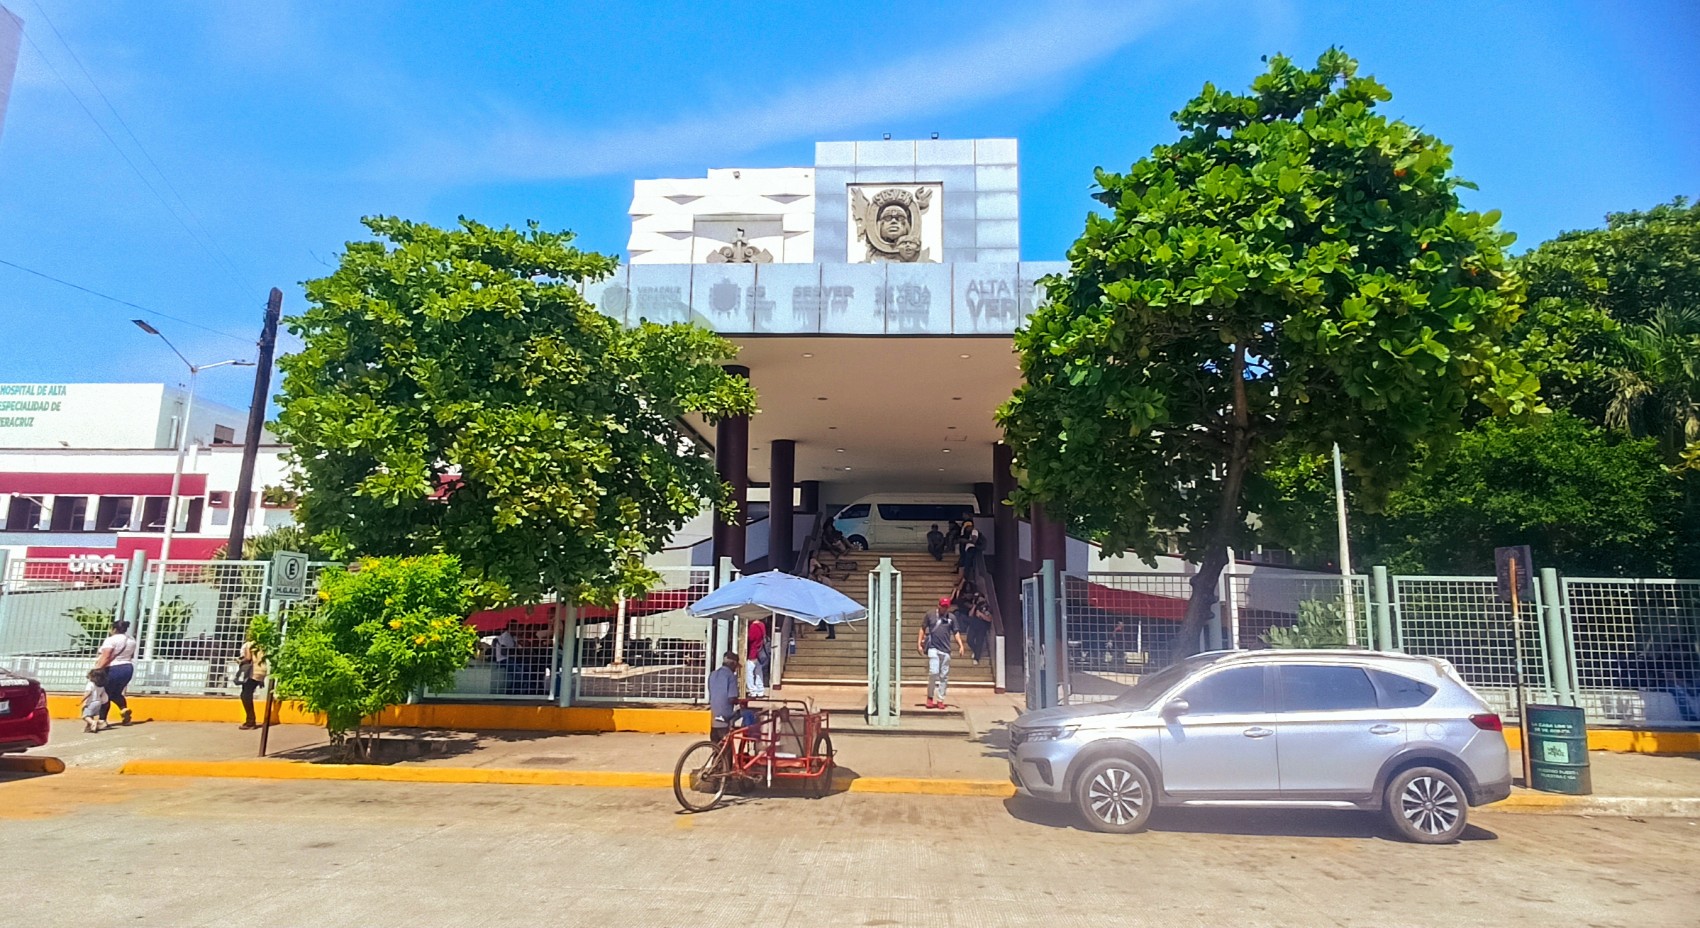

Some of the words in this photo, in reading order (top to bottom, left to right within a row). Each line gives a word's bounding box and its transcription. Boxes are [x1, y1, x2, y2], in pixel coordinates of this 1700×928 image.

[793, 286, 855, 298] SESVER
[965, 279, 1011, 294] ALTA
[0, 385, 35, 396] HOSPITAL
[36, 385, 47, 396] DE
[48, 385, 67, 396] ALTA
[50, 401, 61, 411] DE
[0, 417, 35, 427] ERACRUZ
